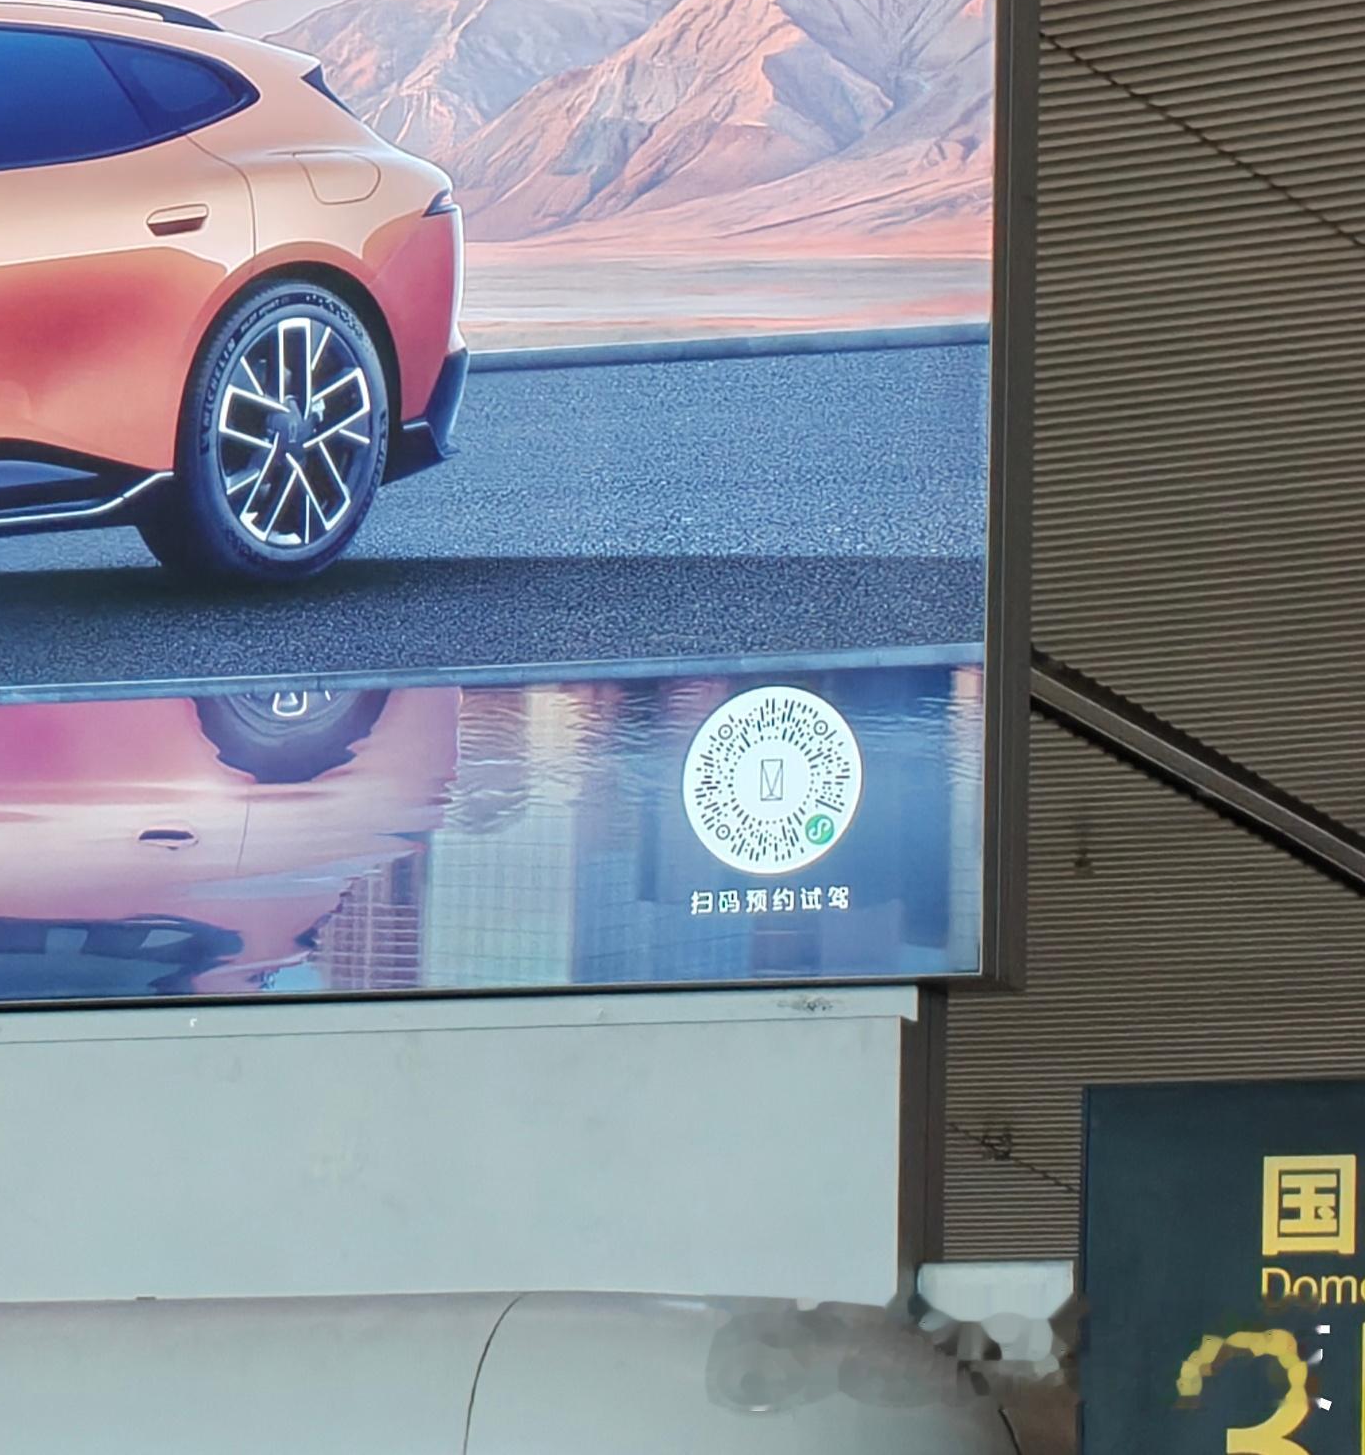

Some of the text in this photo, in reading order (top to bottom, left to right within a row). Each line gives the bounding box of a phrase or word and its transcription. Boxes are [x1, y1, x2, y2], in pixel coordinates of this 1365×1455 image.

[691, 886, 850, 915] 扫码预约试驾
[1262, 1154, 1356, 1256] 国
[1261, 1267, 1365, 1304] Dom
